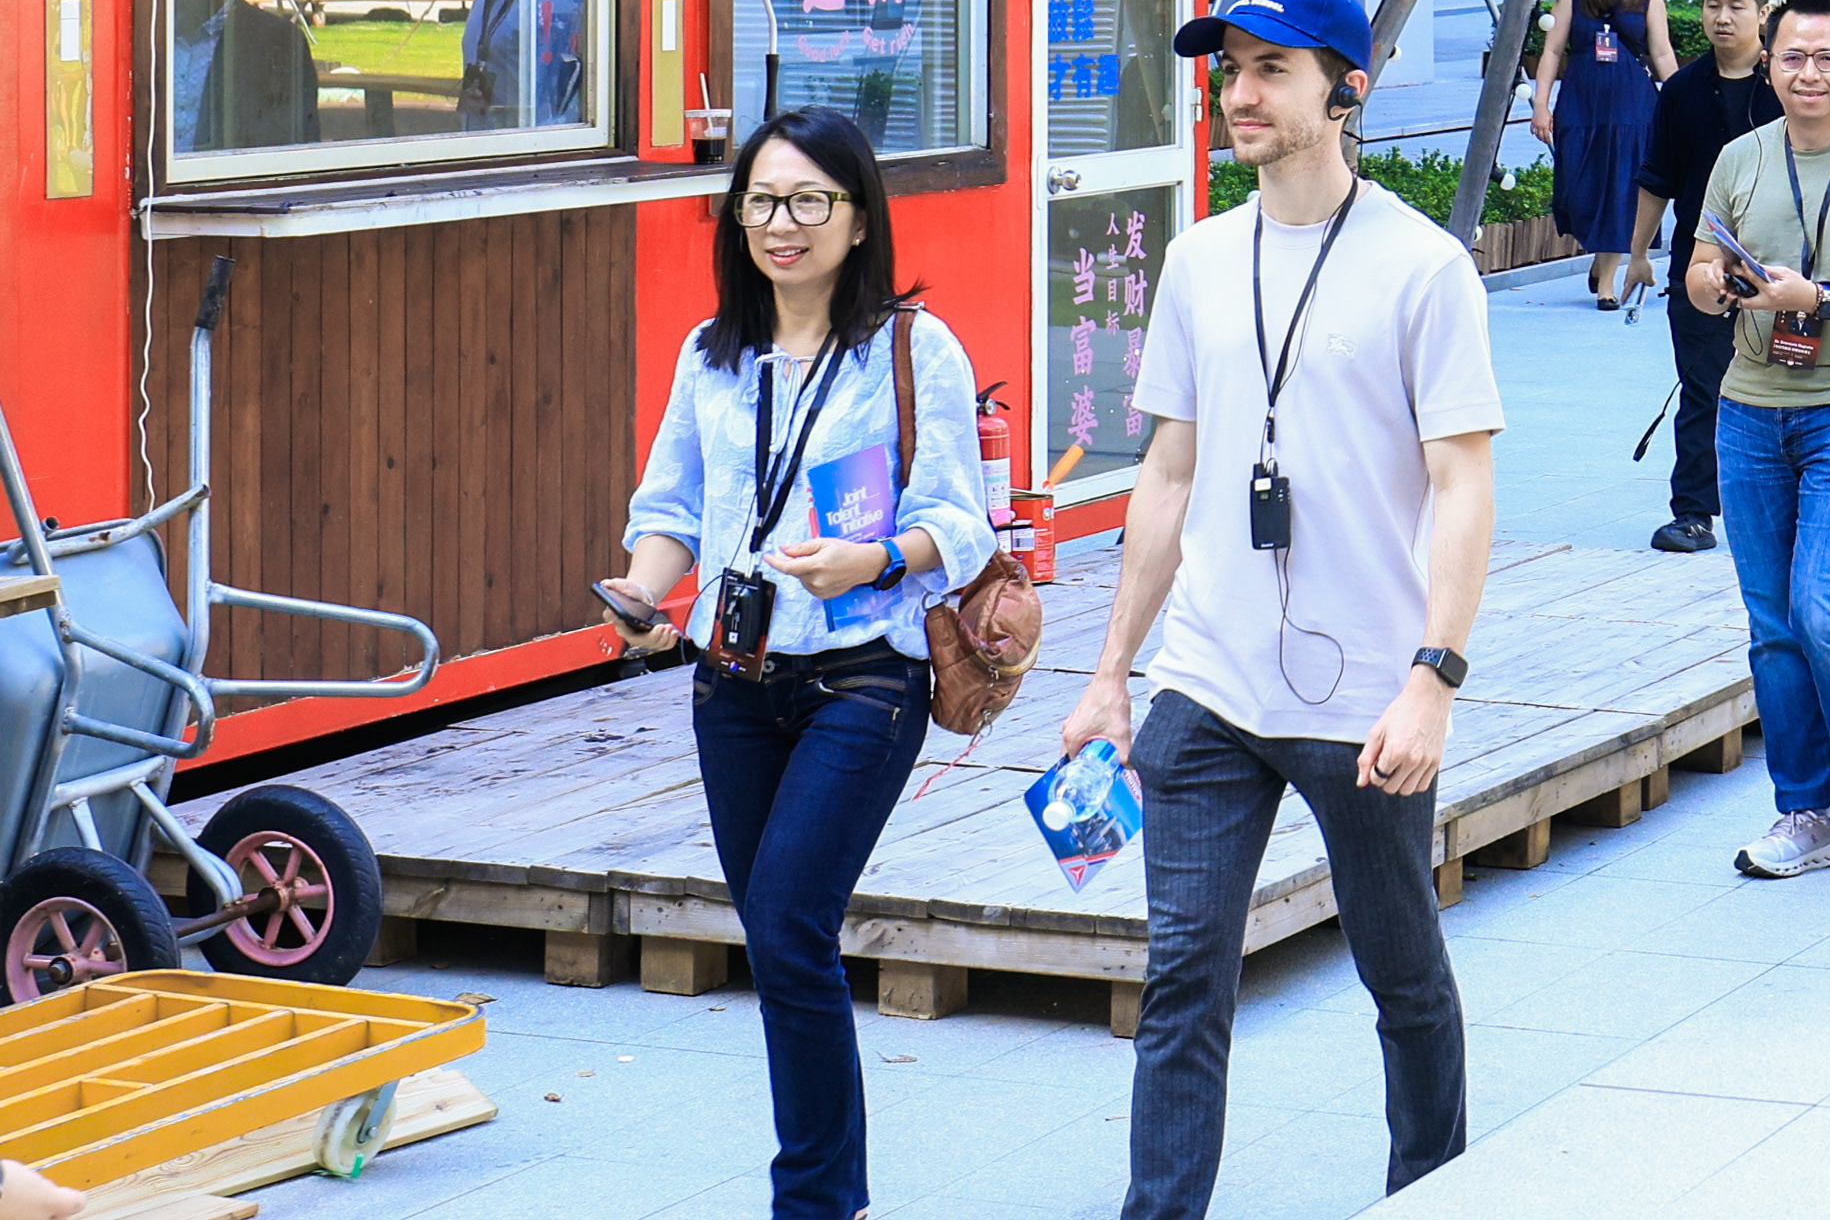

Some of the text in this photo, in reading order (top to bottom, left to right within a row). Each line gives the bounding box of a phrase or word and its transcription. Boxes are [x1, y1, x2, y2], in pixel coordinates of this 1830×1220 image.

[862, 26, 887, 55] Get
[1106, 212, 1121, 336] 人生目标
[1067, 247, 1099, 446] 当富婆
